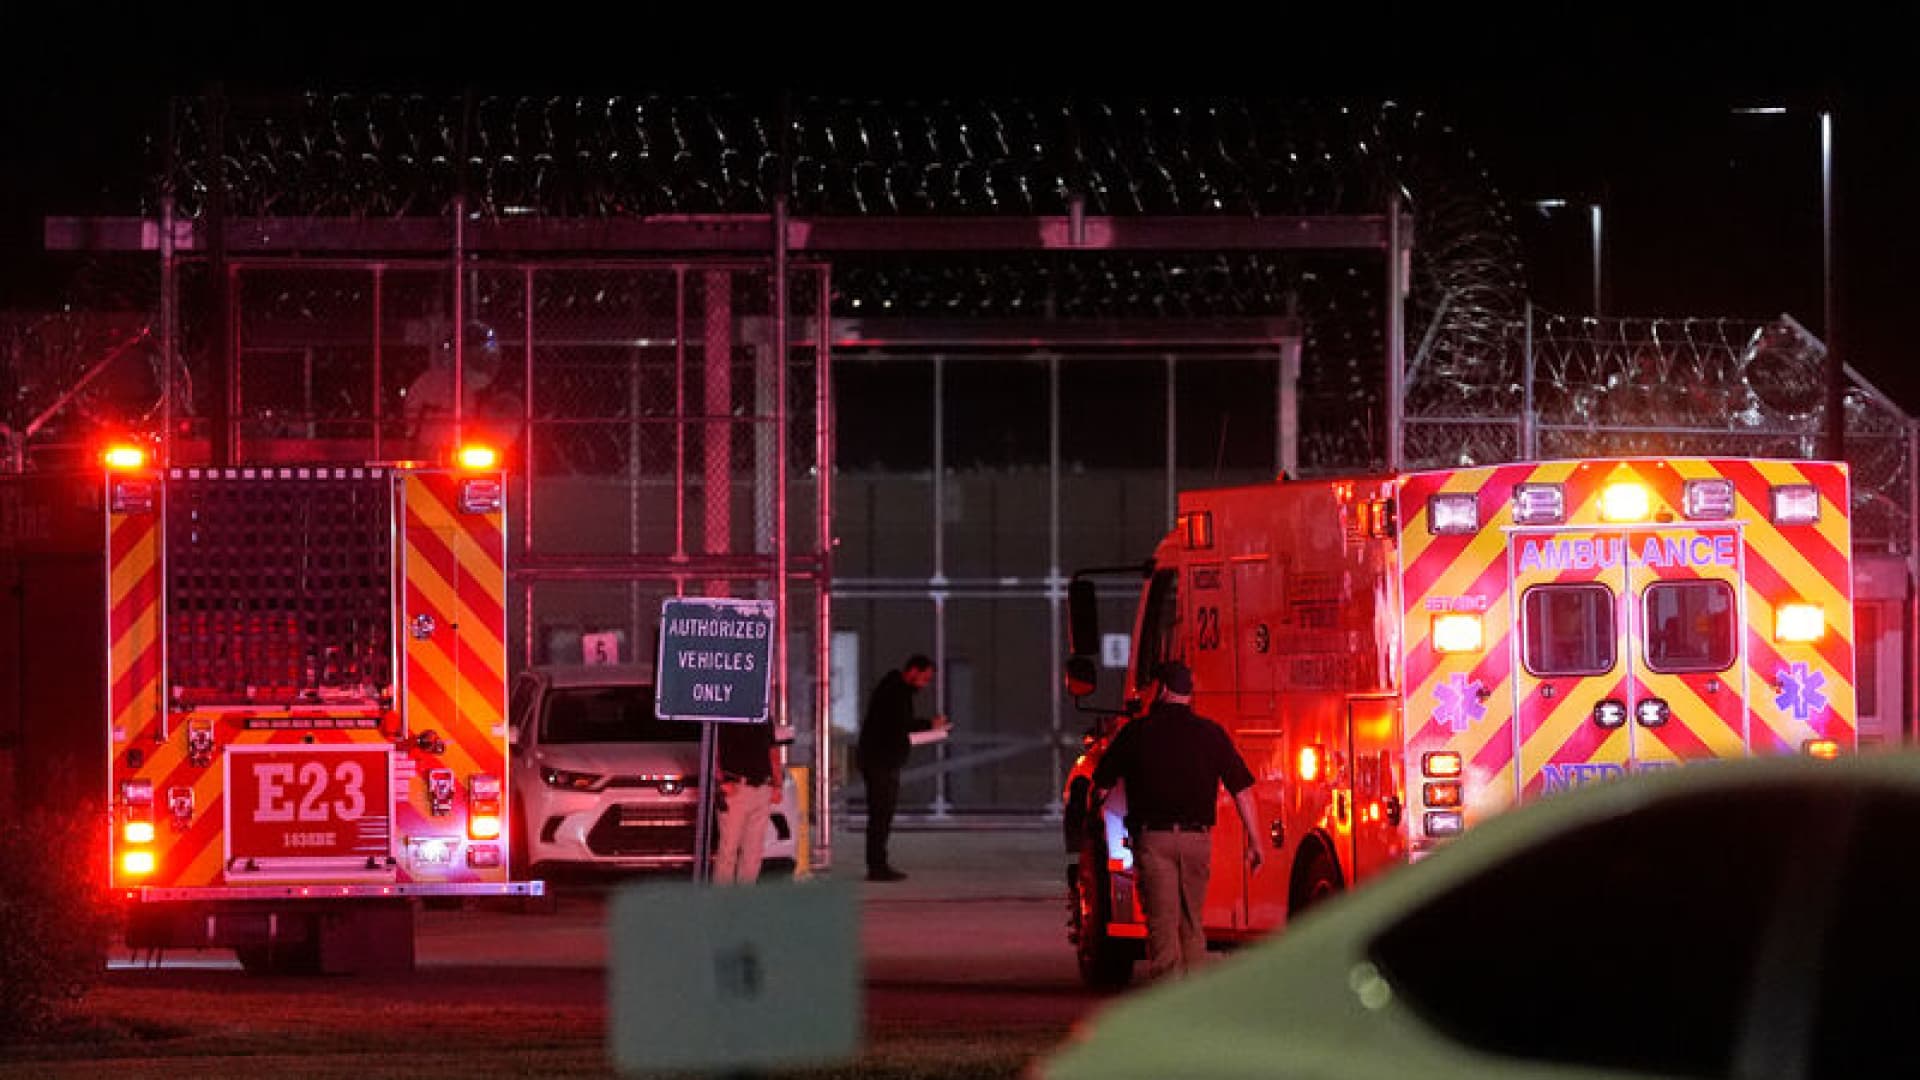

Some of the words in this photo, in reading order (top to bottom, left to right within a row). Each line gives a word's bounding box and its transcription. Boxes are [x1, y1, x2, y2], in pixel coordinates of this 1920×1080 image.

[1519, 536, 1735, 571] AMBULANCE
[669, 618, 767, 639] AUTHORIZED
[1198, 606, 1219, 650] 23
[678, 649, 755, 671] VEHICLES
[693, 683, 733, 702] ONLY
[253, 761, 366, 822] E23
